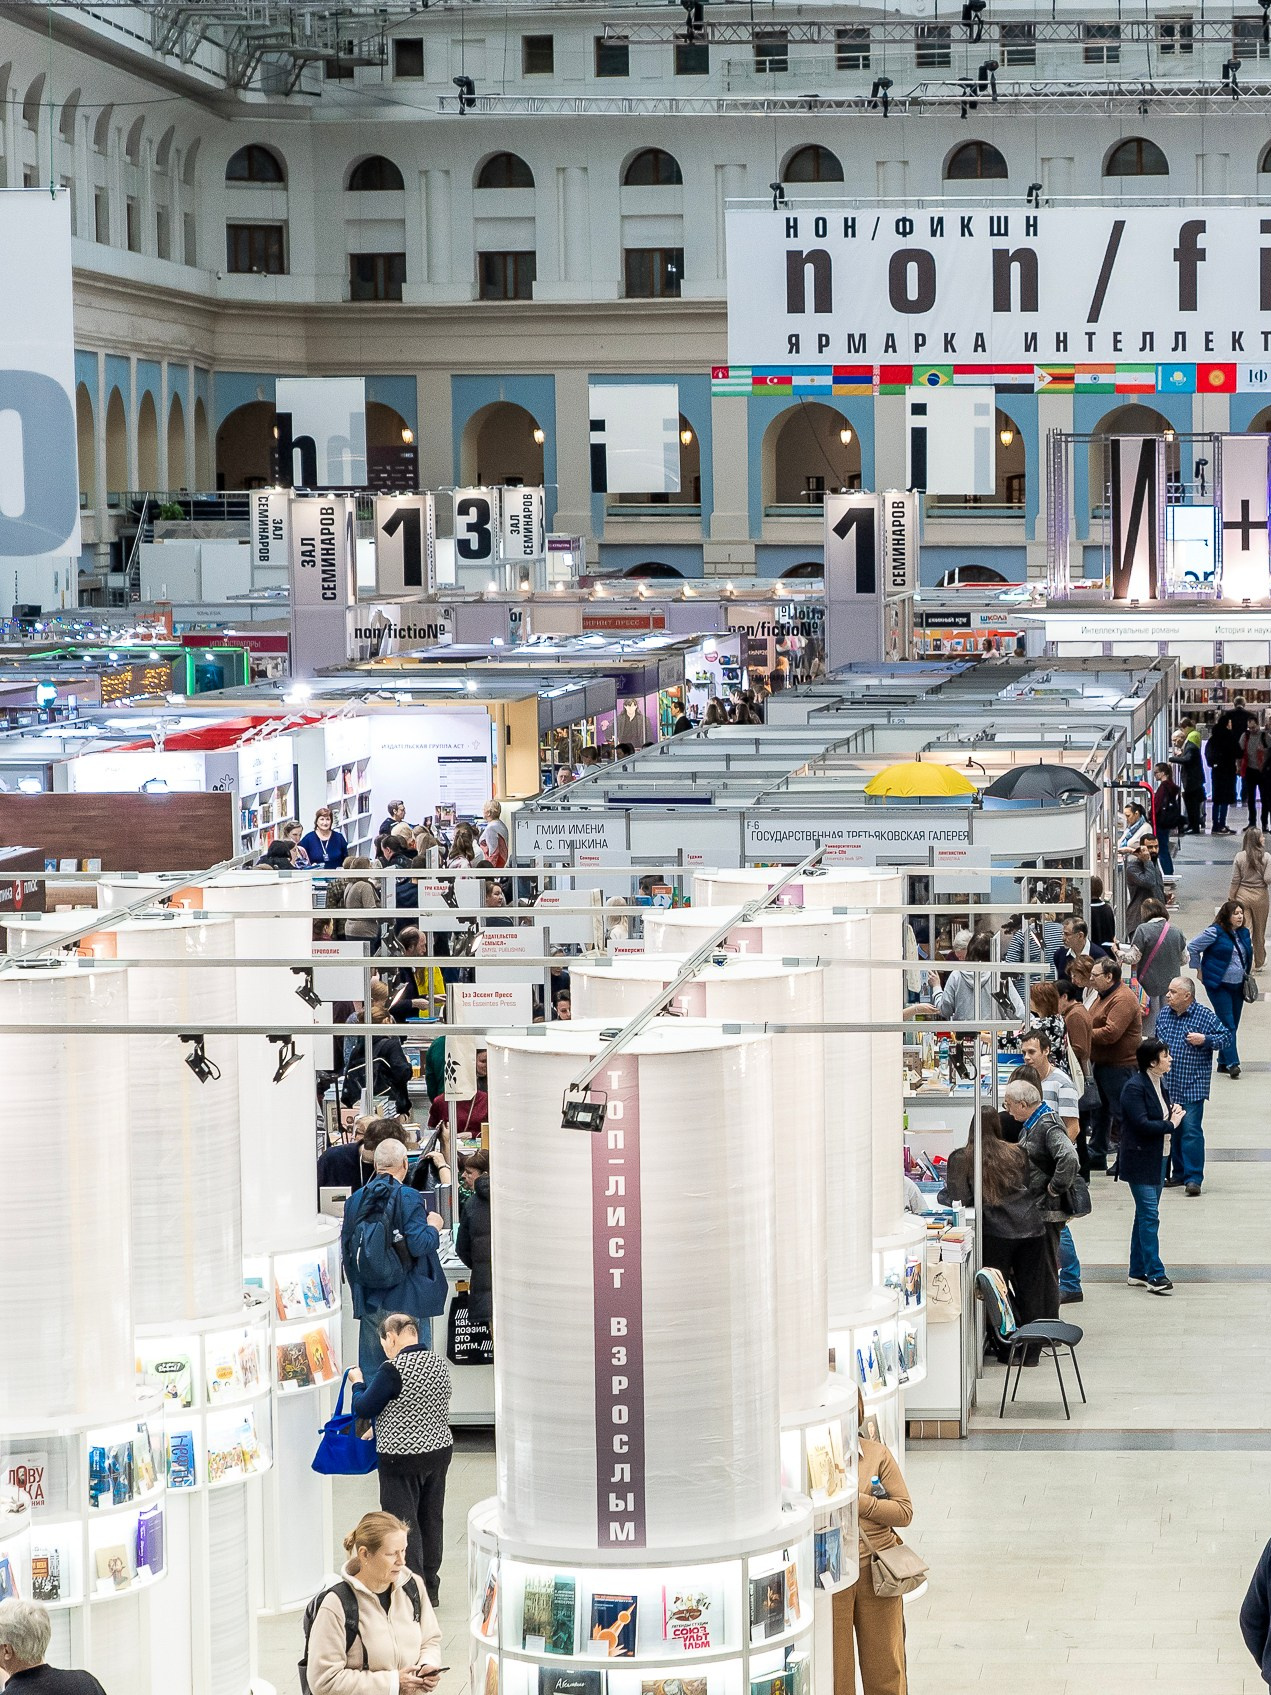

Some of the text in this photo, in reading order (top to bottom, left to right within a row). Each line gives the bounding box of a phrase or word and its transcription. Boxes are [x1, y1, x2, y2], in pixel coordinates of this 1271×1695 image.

[785, 215, 1039, 240] НОН/ФИКШН
[787, 331, 987, 354] ЯРМАРКА
[258, 496, 269, 562] СЕМИНАРОВ
[273, 518, 283, 540] ЗАЛ
[457, 498, 492, 560] 3
[510, 514, 520, 534] ЗАЛ
[523, 493, 533, 556] СЕМИНАРОВ
[301, 537, 316, 568] ЗАЛ
[320, 506, 337, 601] СЕМИНАРОВ
[382, 507, 422, 587] 1
[832, 507, 875, 594] 1
[892, 500, 906, 587] СЕМИНАРОВ
[1081, 626, 1180, 636] Интеллектуальные романы
[1215, 626, 1246, 635] История
[517, 820, 529, 830] F-1
[536, 823, 605, 835] ГМИИ ИМЕНИ
[746, 820, 759, 830] F-6
[751, 830, 969, 842] ГОСУДАРСТВЕННАЯ ТРЕТЬЯКОВСКАЯ ГАЛЕРЕЯ
[533, 838, 609, 850] А. С. ПУШКИНА
[605, 1070, 636, 1542] ТОП-ЛИСТ ВЗРОСЛЫМ
[455, 1326, 489, 1335] поэзия,
[455, 1342, 480, 1353] ритм.
[682, 1632, 710, 1643] УЛЬТ
